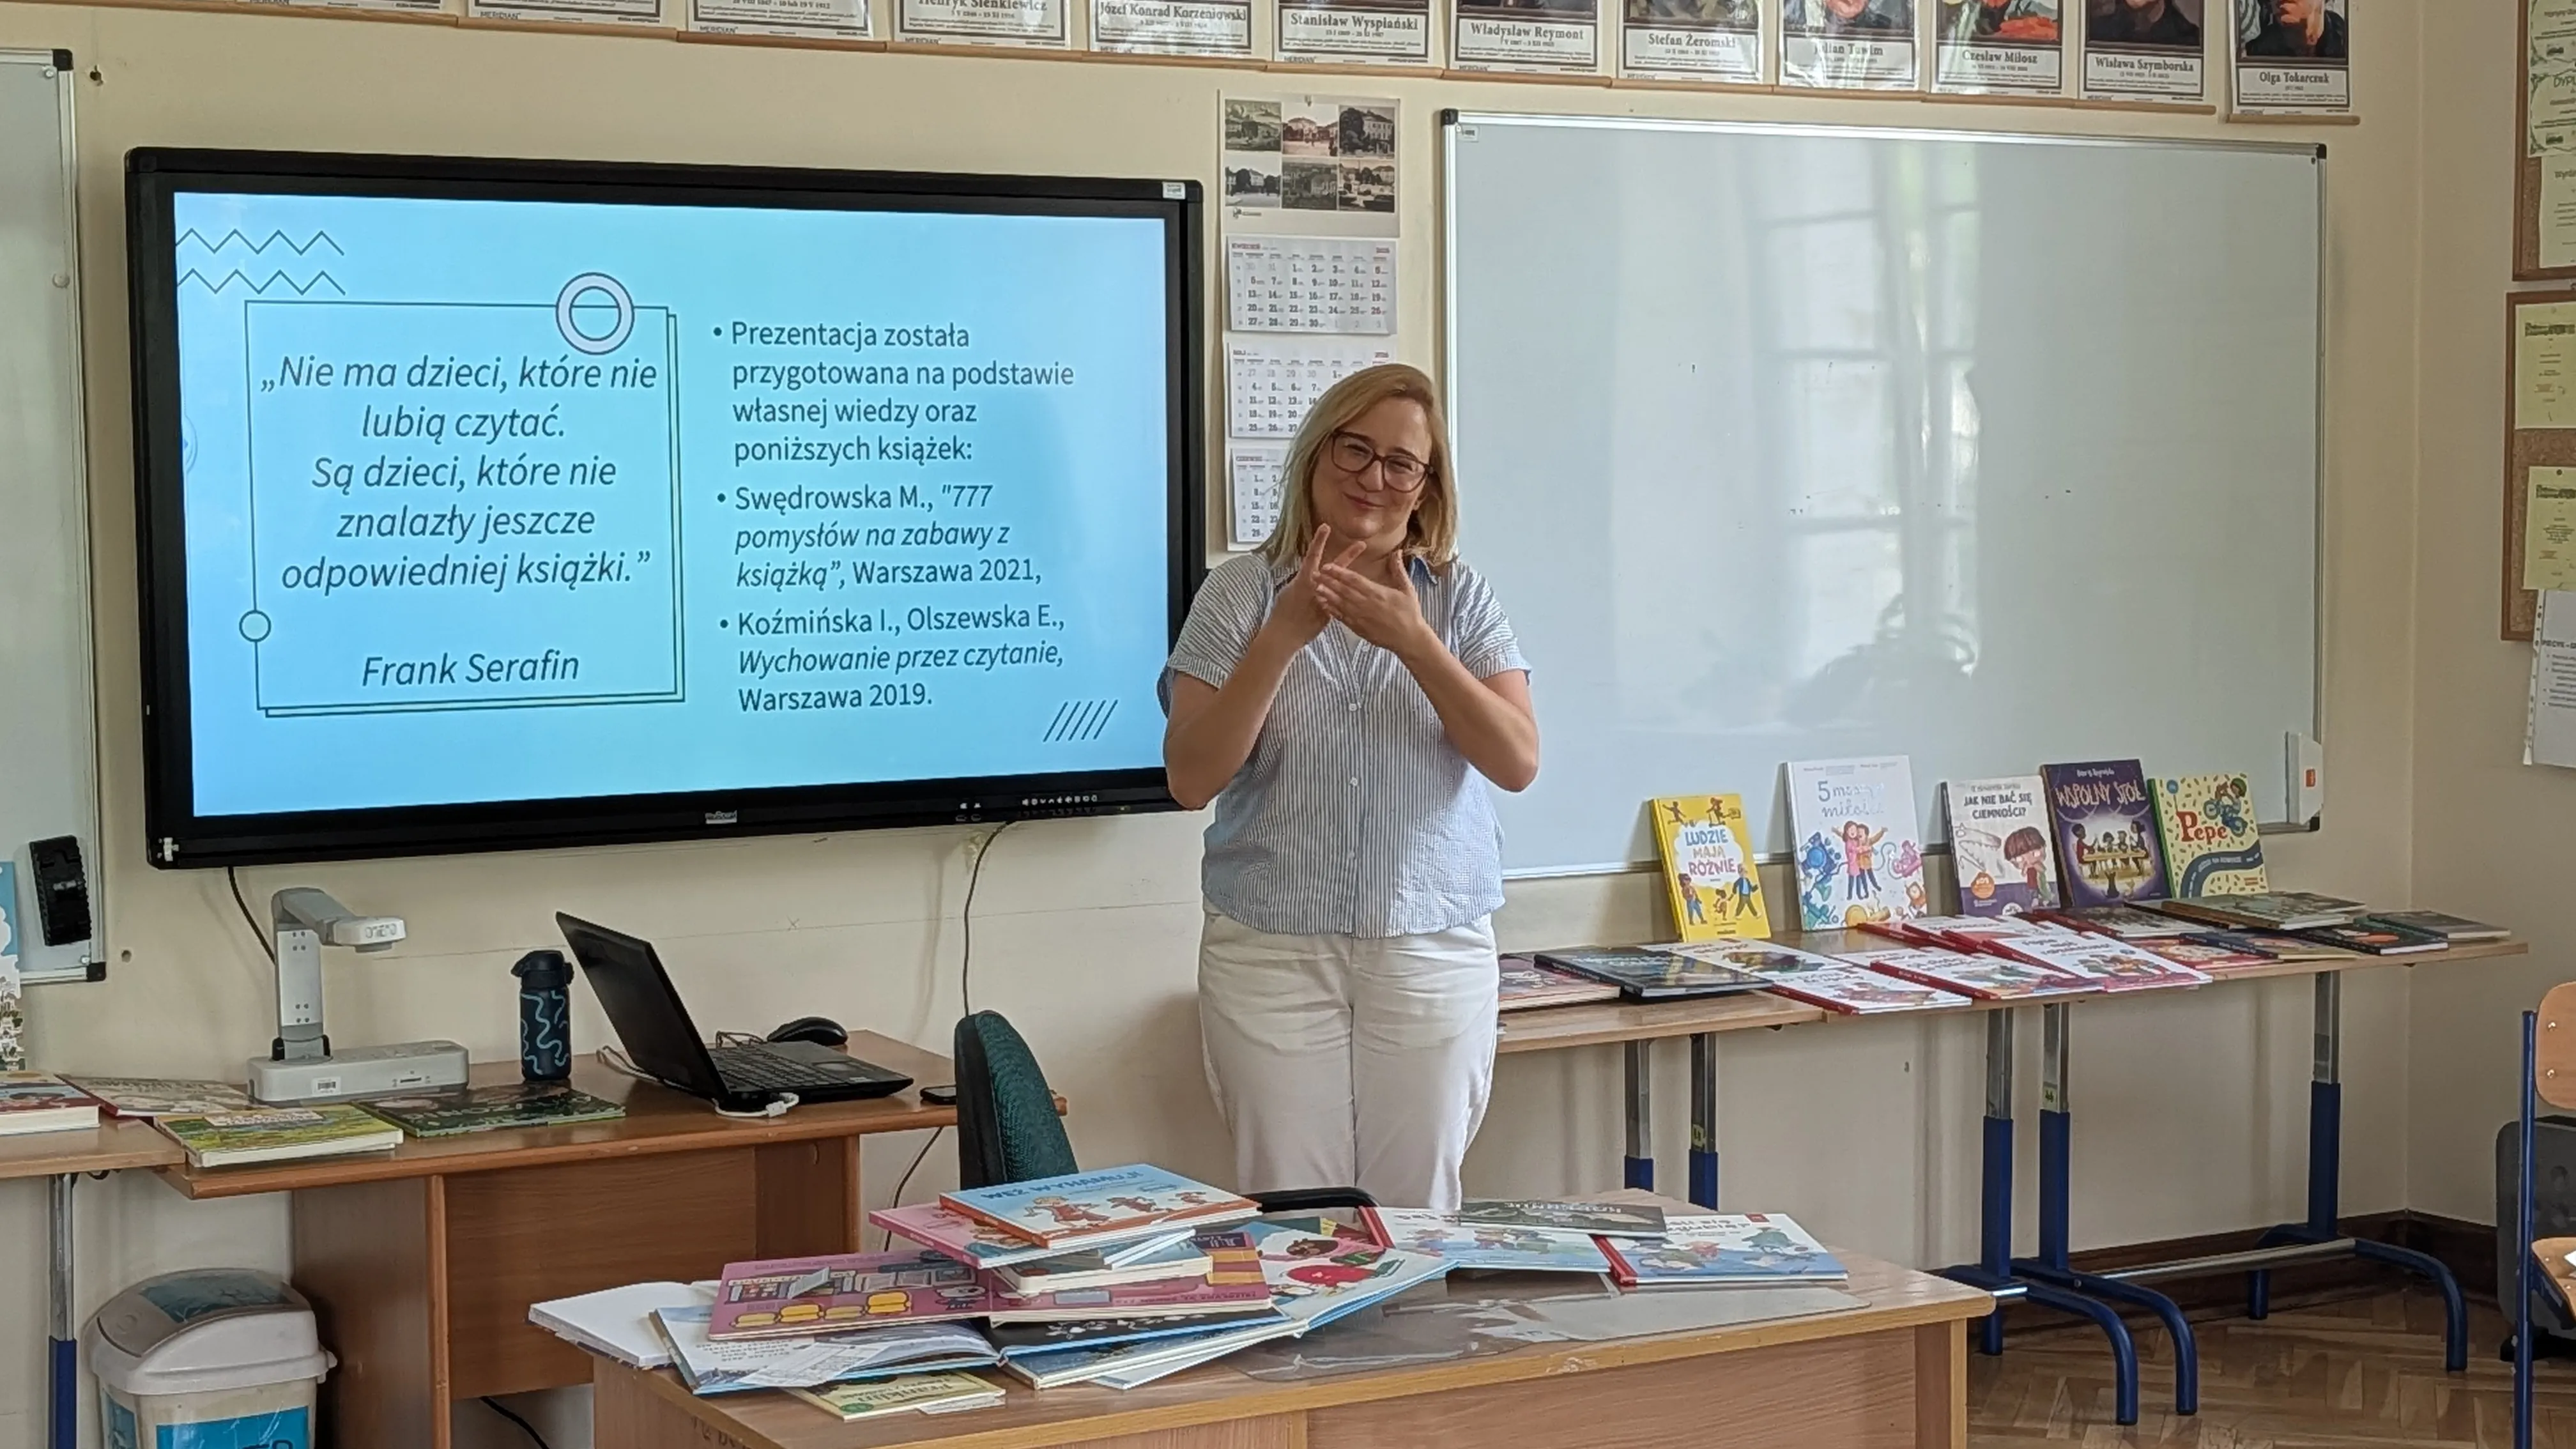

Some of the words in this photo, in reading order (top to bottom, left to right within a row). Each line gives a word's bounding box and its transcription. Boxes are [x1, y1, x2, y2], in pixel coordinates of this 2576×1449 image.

[1130, 4, 1170, 18] Konrad
[1291, 13, 1348, 26] Stanisław
[1352, 15, 1418, 32] Wyspiański
[1471, 22, 1531, 40] Władysław
[1535, 27, 1584, 41] Reymont
[1648, 33, 1682, 45] Stefan
[1686, 33, 1736, 49] Żeromski
[1962, 49, 2002, 63] Czesław
[2005, 52, 2037, 64] Miłosz
[2095, 56, 2135, 69] Wisława
[2137, 58, 2194, 73] Szymborska
[2260, 72, 2281, 85] Olga
[2283, 72, 2330, 84] Tokarczuk
[731, 320, 877, 353] Prezentacja
[884, 321, 970, 348] została
[261, 355, 335, 393] „Nie
[343, 361, 397, 388] ma
[406, 355, 508, 394] dzieci,
[519, 355, 602, 388] które
[610, 357, 657, 388] nie
[732, 364, 909, 391] przygotowana
[916, 365, 945, 385] na
[953, 360, 1075, 392] podstawie
[362, 404, 445, 445] lubią
[454, 402, 565, 445] czytać.
[732, 397, 828, 429] własnej
[835, 397, 919, 429] wiedzy
[924, 402, 977, 424] oraz
[734, 434, 871, 468] poniższych
[878, 434, 973, 466] książek:
[310, 457, 355, 496] Są
[363, 455, 466, 493] dzieci,
[477, 452, 561, 487] które
[569, 455, 617, 487] nie
[735, 484, 892, 516] Swędrowska
[899, 484, 934, 513] M.,
[942, 484, 994, 508] "777
[335, 503, 476, 545] znalazły
[478, 505, 595, 545] jeszcze
[734, 521, 860, 555] pomysłów
[865, 525, 896, 548] na
[900, 520, 994, 551] zabawy
[997, 525, 1010, 544] z
[281, 553, 509, 597] odpowiedniej
[516, 549, 652, 591] książki.”
[735, 560, 847, 592] książką”,
[852, 560, 974, 585] Warszawa
[979, 558, 1042, 584] 2021,
[739, 607, 872, 636] Koźmińska
[879, 608, 901, 637] I.,
[907, 603, 1031, 631] Olszewska
[1038, 604, 1065, 631] E.,
[362, 652, 457, 686] Frank
[464, 648, 579, 683] Serafin
[739, 645, 891, 680] Wychowanie
[895, 648, 958, 675] przez
[963, 640, 1064, 671] czytanie,
[739, 686, 862, 712] Warszawa
[869, 682, 933, 707] 2019.
[1818, 781, 1830, 802] 5
[1963, 796, 1979, 807] JAK
[1981, 795, 1996, 806] NIE
[1685, 829, 1728, 847] LUDZIE
[2175, 811, 2228, 845] Pepe
[1688, 859, 1736, 877] RÓŻNIE
